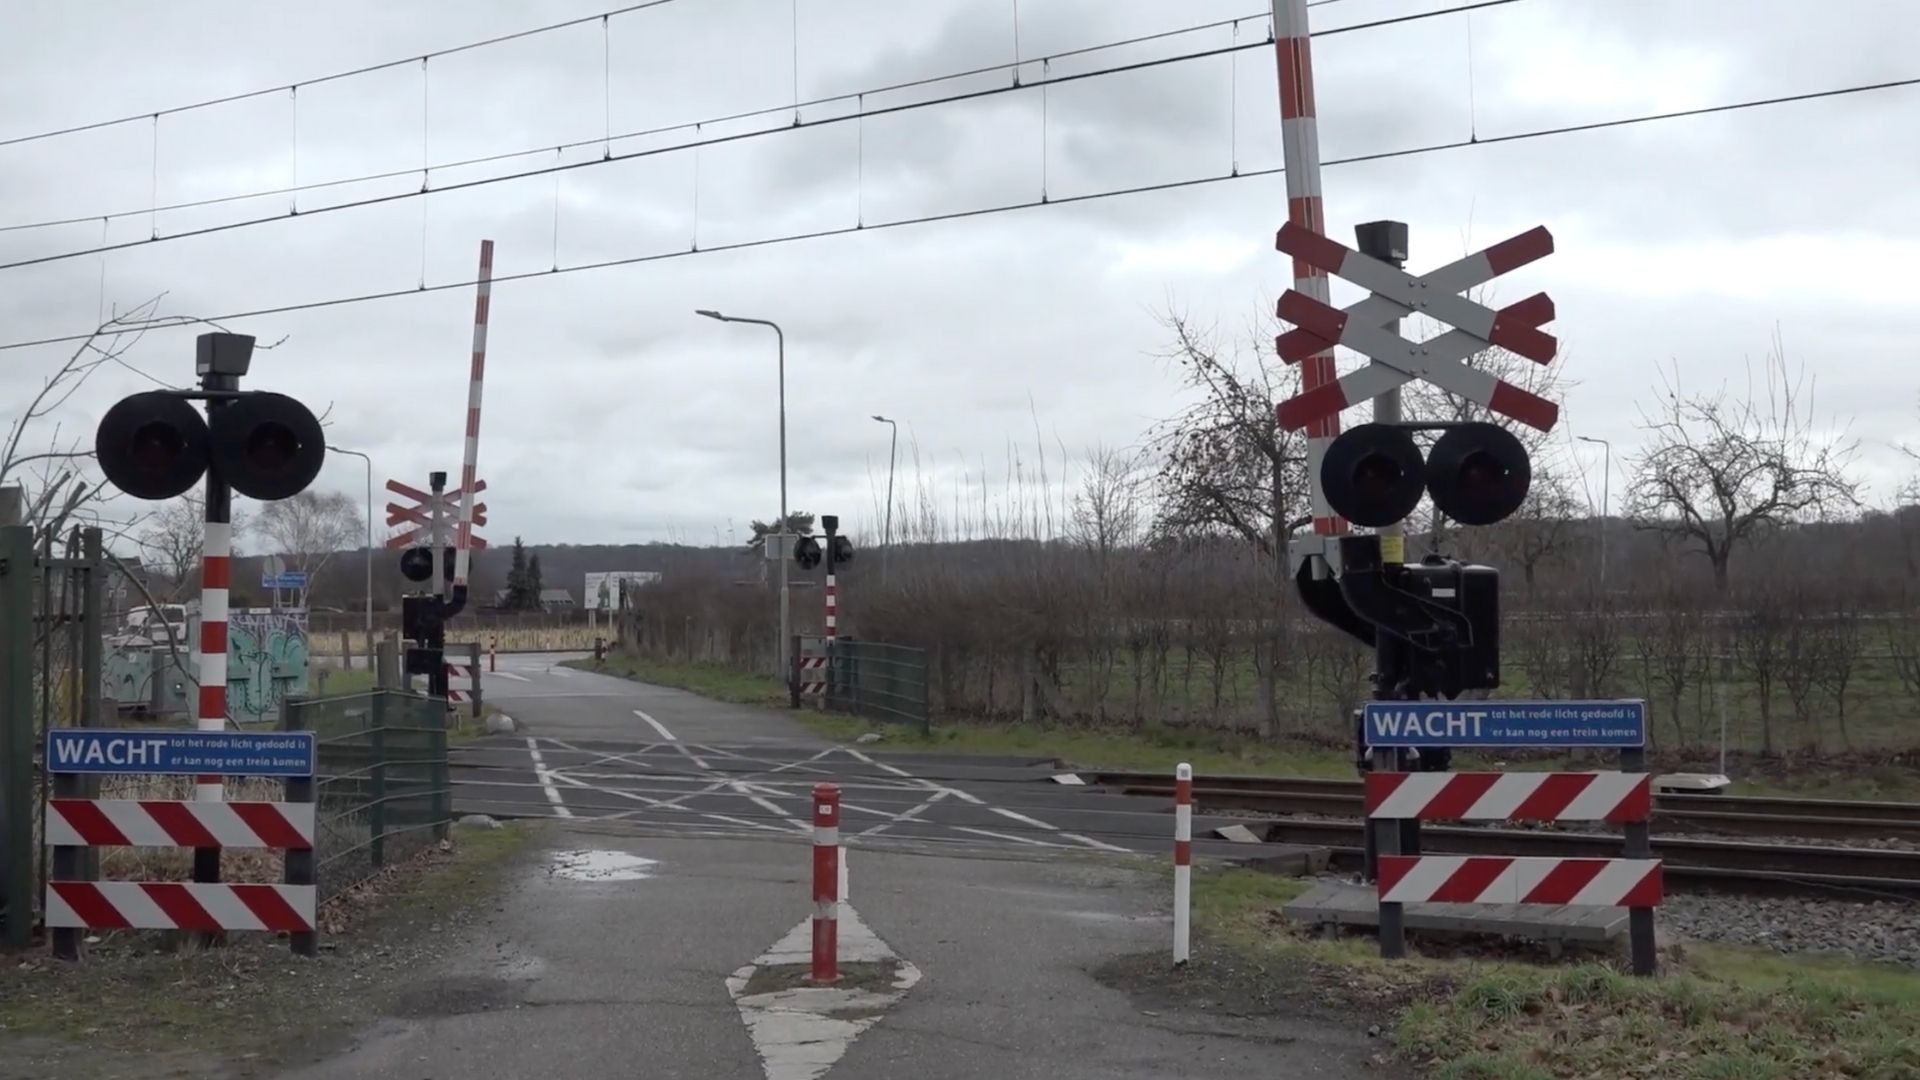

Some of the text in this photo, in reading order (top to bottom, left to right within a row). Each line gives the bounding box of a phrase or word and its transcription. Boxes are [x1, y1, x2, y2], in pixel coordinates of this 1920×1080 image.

[1492, 709, 1636, 721] tot het rode licht gedoofd is
[1373, 712, 1487, 737] WACHT
[1492, 727, 1637, 739] er kan nog een trein komen
[171, 739, 306, 751] tot het rode licht gedoofd is
[55, 738, 167, 765] WACHT
[184, 756, 201, 766] kan
[204, 758, 224, 768] nog
[226, 758, 243, 766] een
[246, 757, 270, 766] trein
[272, 757, 306, 767] komen
